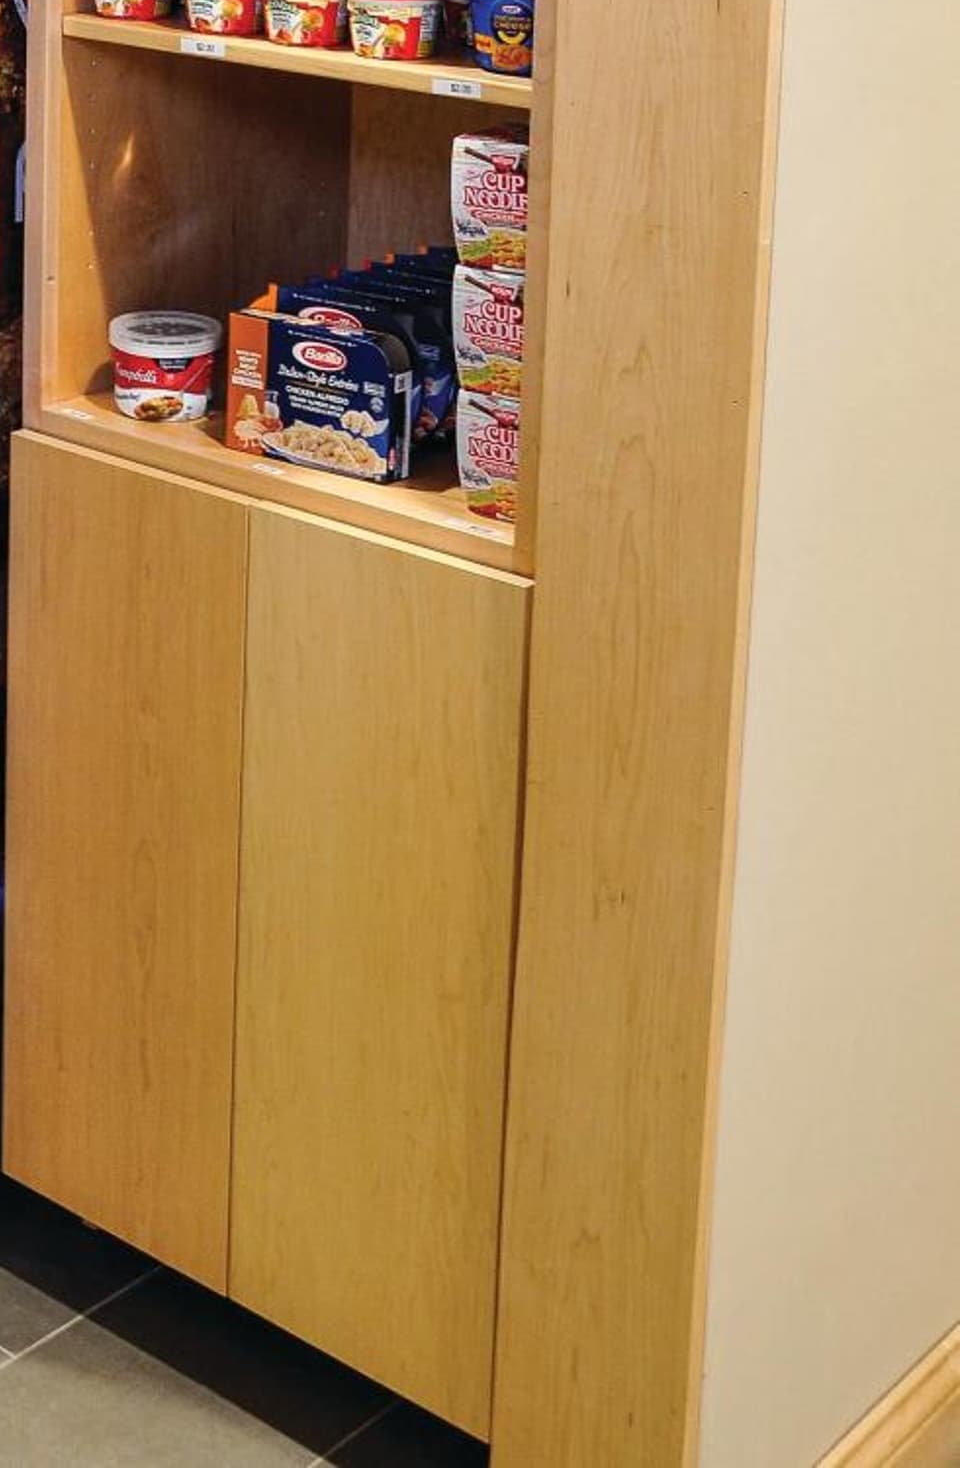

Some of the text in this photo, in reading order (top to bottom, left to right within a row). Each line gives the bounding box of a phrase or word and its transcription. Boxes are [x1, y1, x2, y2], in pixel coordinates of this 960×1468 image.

[482, 171, 525, 193] CUP
[464, 187, 529, 211] NOODLE
[481, 300, 522, 324] CUP
[468, 436, 517, 465] NOOD
